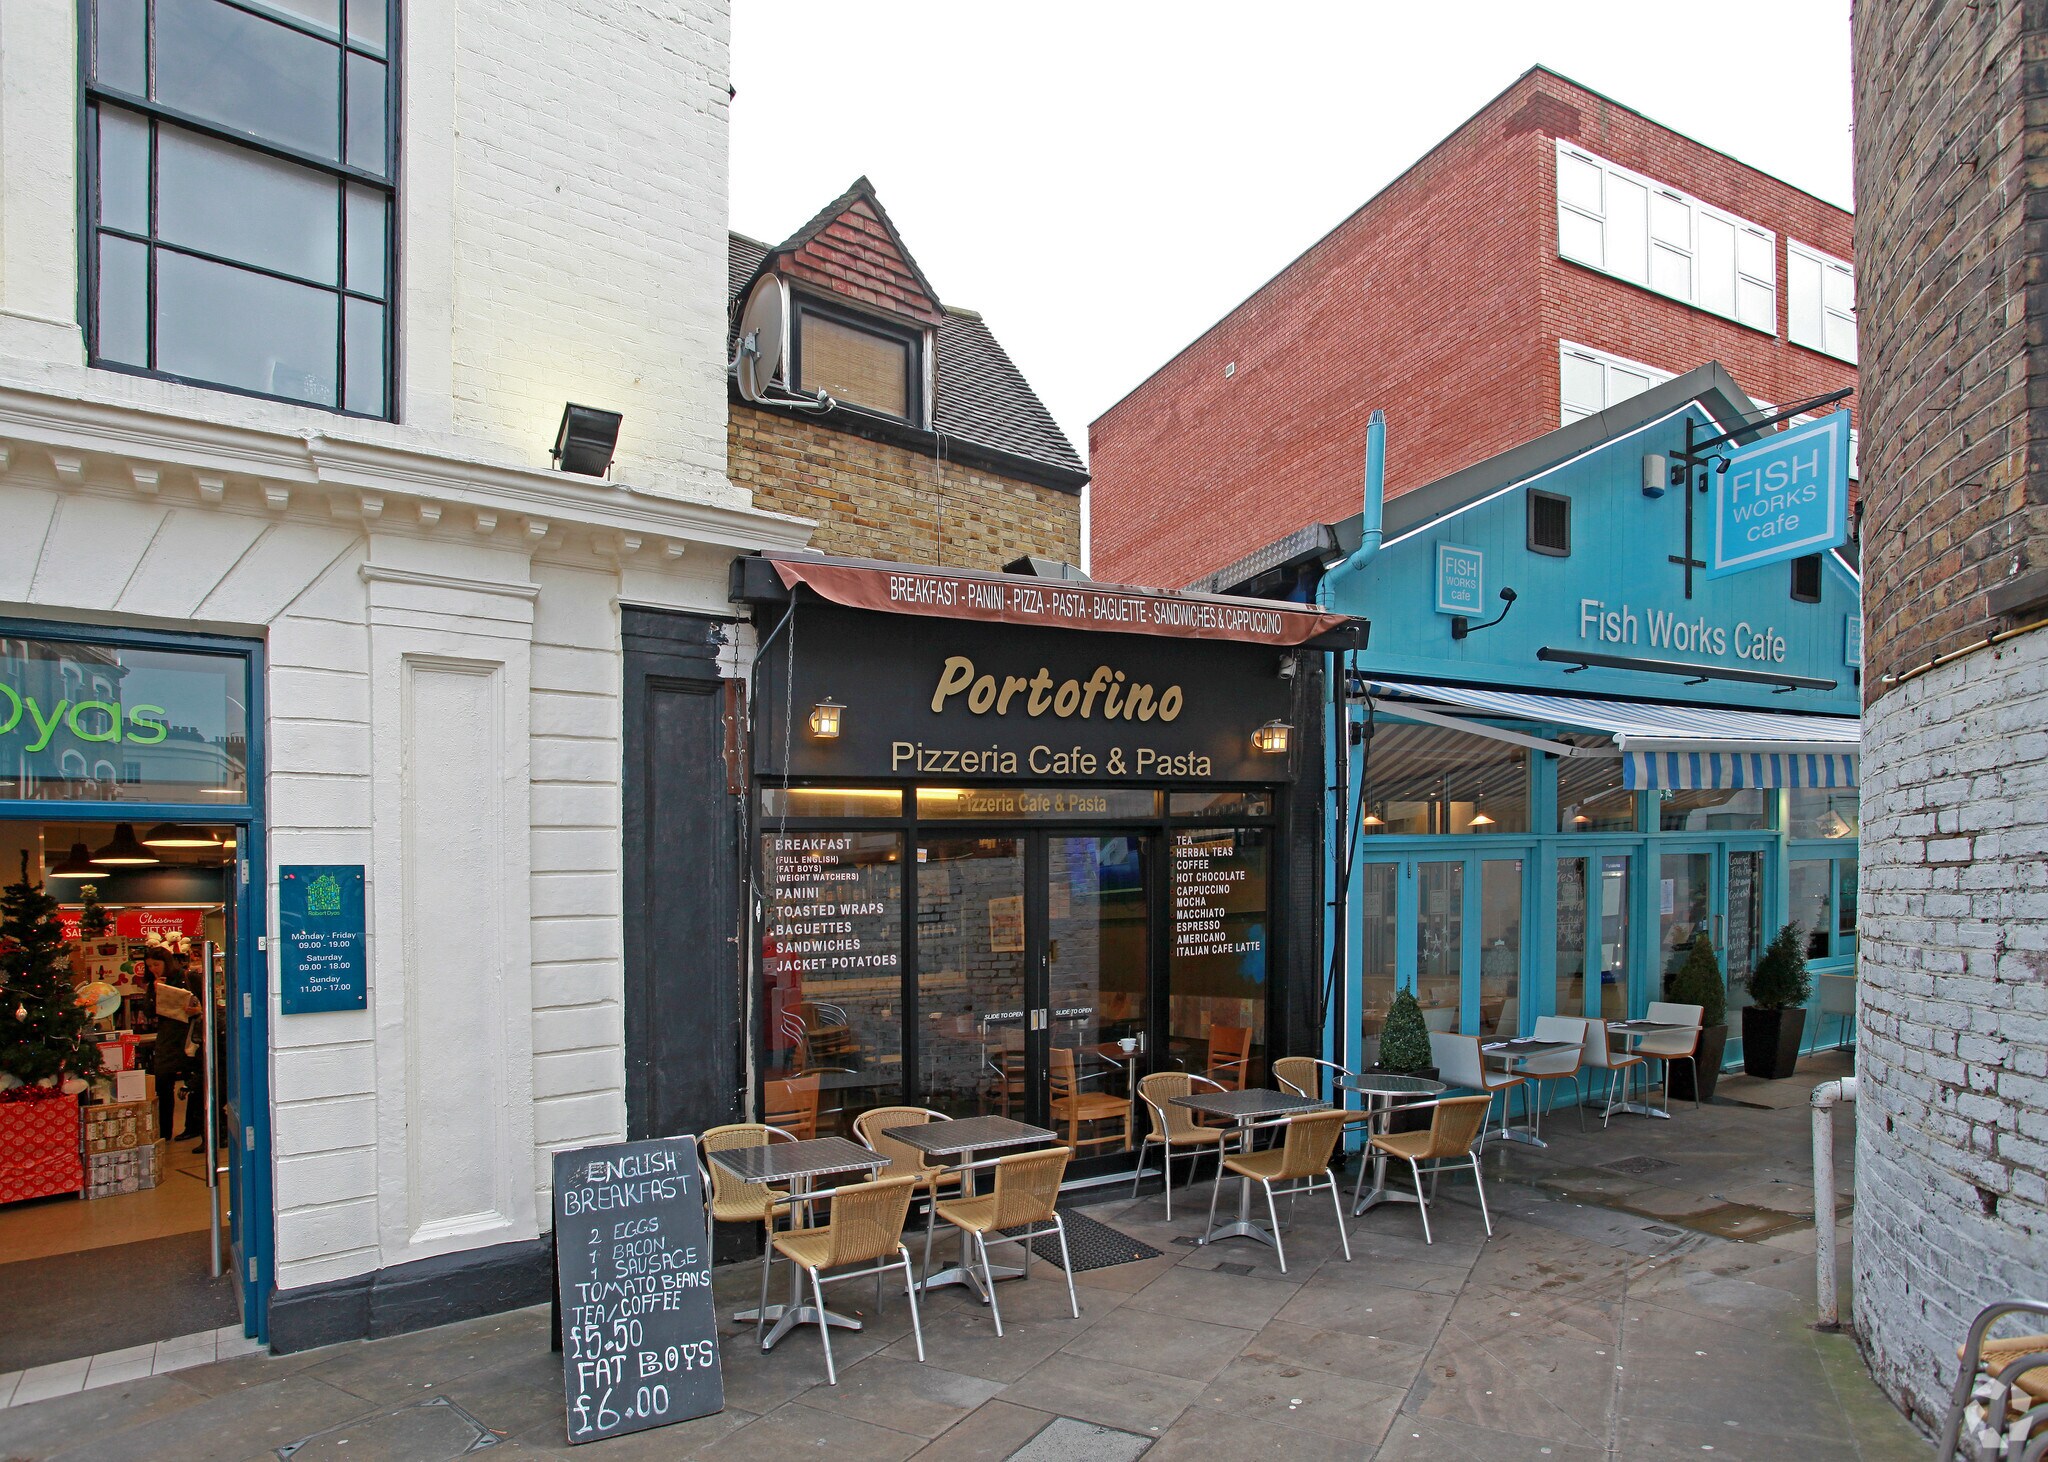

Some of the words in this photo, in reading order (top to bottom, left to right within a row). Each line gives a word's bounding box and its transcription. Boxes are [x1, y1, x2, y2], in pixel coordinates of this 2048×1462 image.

[1733, 448, 1818, 503] FISH
[1733, 484, 1817, 524] WORKS
[1747, 512, 1800, 542] cafe
[1446, 557, 1477, 578] FISH
[1446, 576, 1477, 589] WORKS
[1451, 589, 1470, 601] cafe
[890, 576, 959, 606] BREAKFAST
[968, 583, 1004, 610] PANINI
[1013, 588, 1044, 614] PIZZA
[1052, 592, 1086, 619] PASTA
[1093, 597, 1147, 623] BAGUETTE
[1154, 601, 1216, 628] SANDWICHES
[1218, 610, 1225, 629] &
[1225, 609, 1282, 635] CAPPUCCINO
[1580, 598, 1638, 645] Fish
[1647, 608, 1726, 656] Works
[1734, 622, 1785, 663] Cafe
[931, 655, 1183, 722] Portofino
[891, 741, 1018, 774] Pizzeria
[1029, 745, 1097, 774] Cafe
[1106, 747, 1127, 775] &
[1136, 748, 1212, 776] Pasta
[957, 793, 1014, 813] Pizzeria
[1018, 793, 1050, 812] Cafe
[1054, 793, 1065, 812] &
[1068, 794, 1107, 812] Pasta
[775, 839, 852, 850] BREAKFAST
[1176, 836, 1193, 845] TEA
[1176, 848, 1209, 858] HERBAL
[1213, 847, 1233, 856] TEAS
[775, 856, 798, 864] (FULL
[802, 855, 839, 864] ENGLISH)
[1176, 860, 1209, 870] COFFEE
[797, 865, 822, 873] BOYS)
[776, 874, 810, 883] (WEIGHT
[813, 873, 859, 881] WATCHERS)
[1176, 873, 1193, 883] HOT
[1196, 871, 1245, 882] CHOCOLATE
[775, 887, 819, 899] PANINI
[1176, 884, 1230, 896] CAPPUCCINO
[1176, 897, 1206, 907] MOCHA
[776, 905, 835, 917] TOASTED
[840, 903, 884, 915] WRAPS
[1176, 908, 1225, 920] MACCHIATO
[139, 912, 185, 924] Christmas
[140, 926, 160, 935] GIFT
[161, 926, 182, 934] SALE
[776, 922, 852, 935] BAGUETTES
[1176, 920, 1220, 932] ESPRESSO
[291, 933, 325, 941] Monday
[332, 932, 357, 940] Friday
[1176, 932, 1226, 945] AMERICANO
[776, 939, 860, 953] SANDWICHES
[1176, 945, 1209, 957] ITALIAN
[1212, 944, 1233, 954] CAFE
[1236, 942, 1260, 952] LATTE
[306, 954, 343, 962] Saturday
[776, 958, 827, 972] JACKET
[832, 954, 897, 969] POTATOES
[300, 985, 322, 993] 11.00
[586, 1151, 677, 1183] ENGLISH
[564, 1174, 692, 1216] BREAKFAST
[589, 1229, 602, 1245] 2
[614, 1217, 659, 1240] EGGS
[589, 1251, 599, 1264] 1
[613, 1237, 666, 1261] BACON
[591, 1268, 598, 1280] 1
[616, 1247, 698, 1279] SAUSAGE
[575, 1274, 657, 1303] TOMATO
[663, 1270, 710, 1289] BEANS
[570, 1318, 644, 1360] £5.50
[577, 1355, 627, 1394] FAT
[639, 1340, 714, 1378] BOYS
[573, 1384, 669, 1435] £6.00
